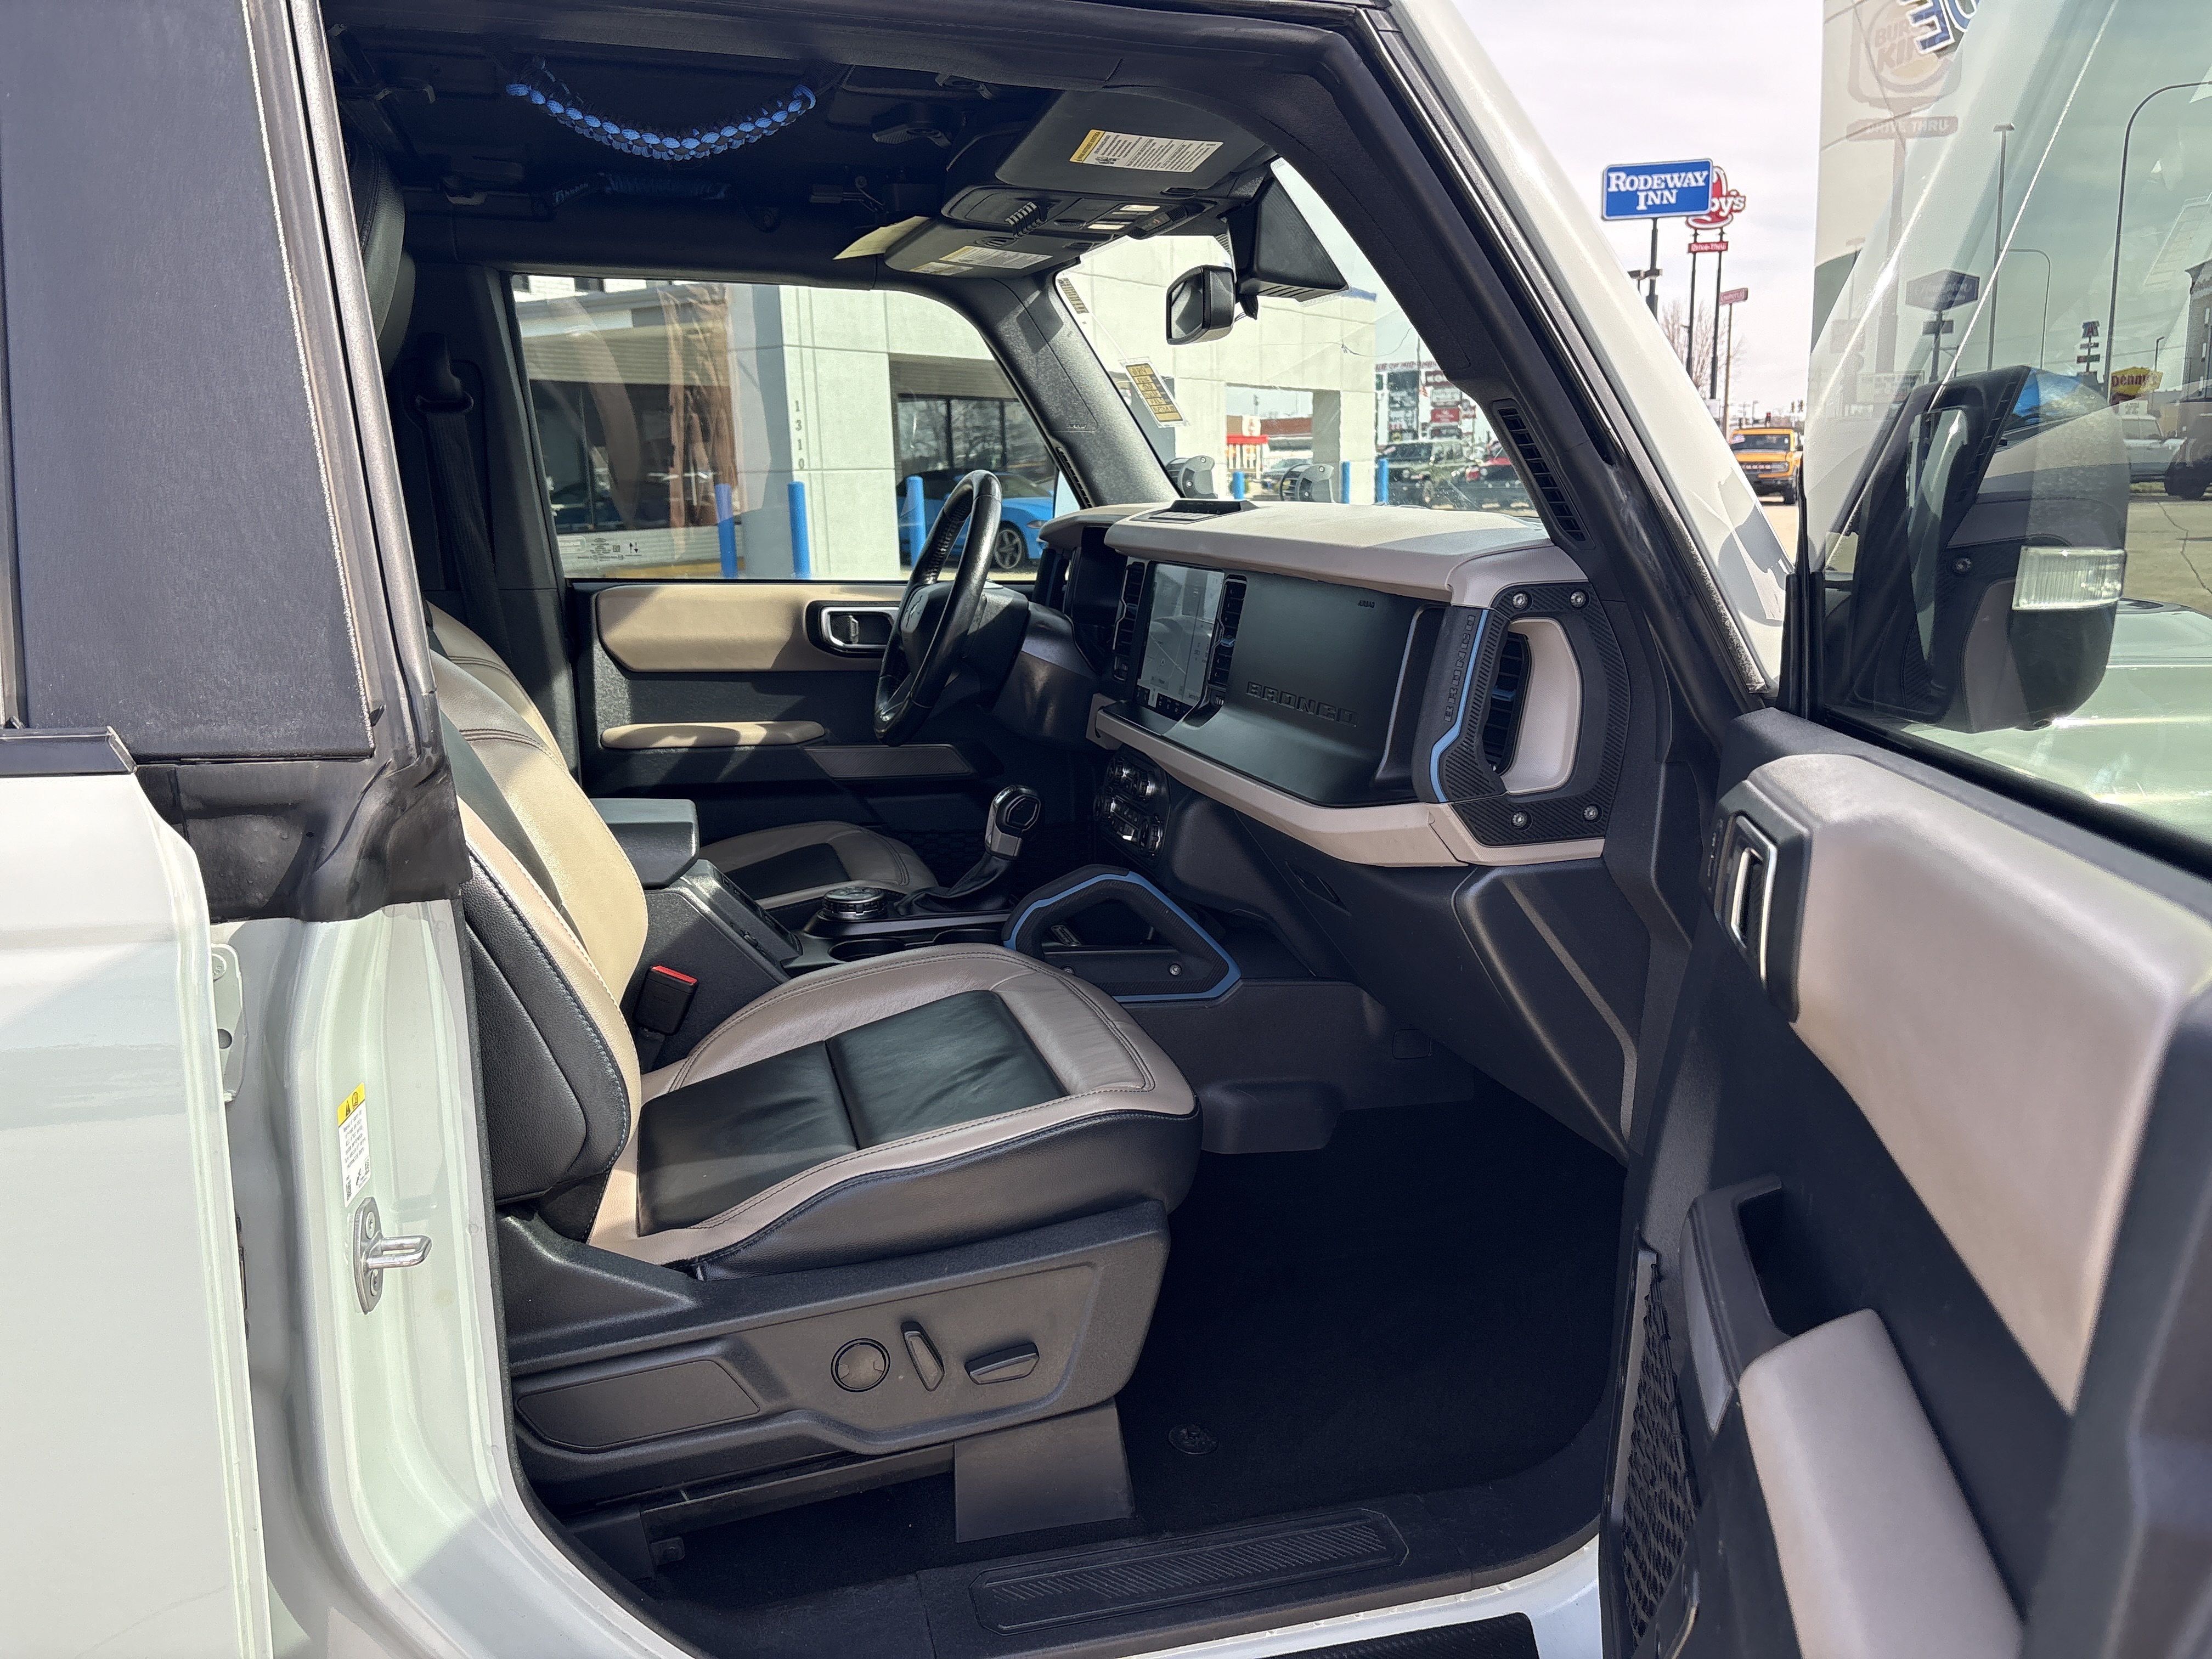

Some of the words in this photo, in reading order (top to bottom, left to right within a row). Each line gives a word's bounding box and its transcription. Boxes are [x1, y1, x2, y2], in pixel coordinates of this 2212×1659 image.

[1607, 170, 1708, 193] RODEWAY
[1636, 189, 1678, 210] INN
[1444, 614, 1476, 723] BRONCO
[1245, 681, 1359, 727] BRONCO
